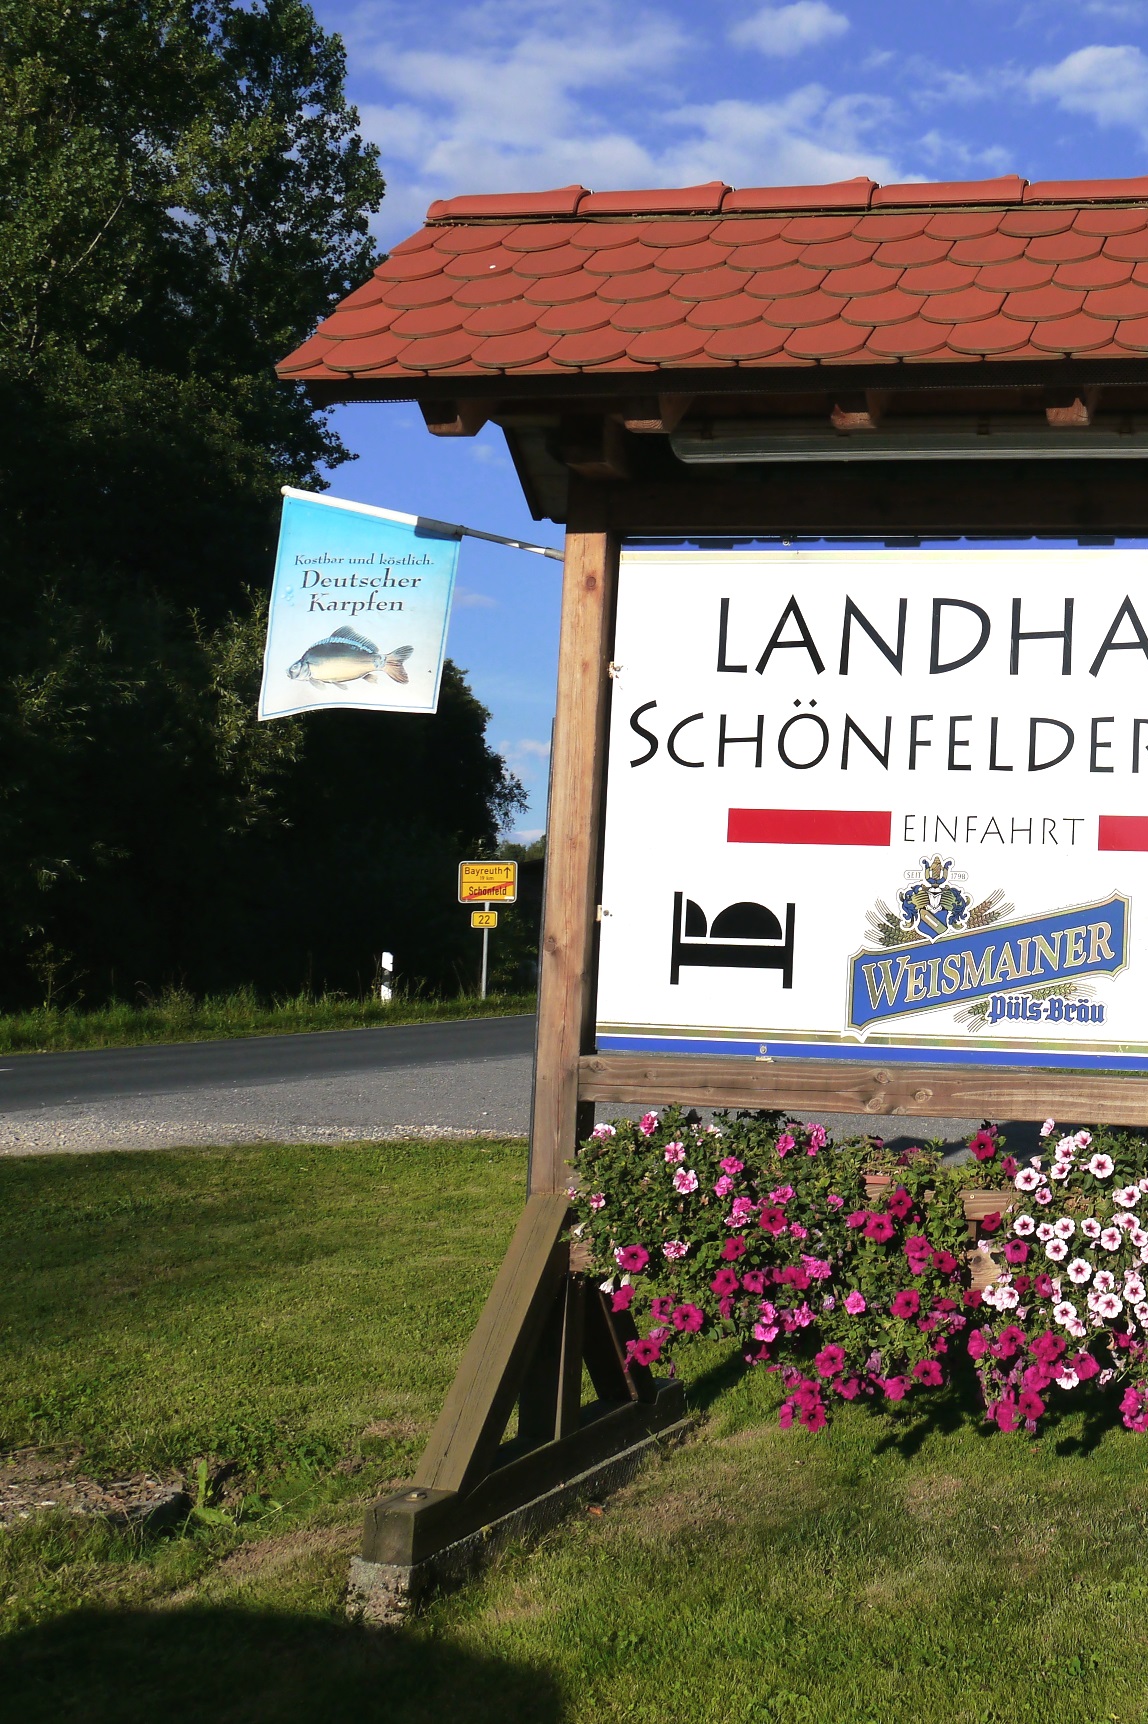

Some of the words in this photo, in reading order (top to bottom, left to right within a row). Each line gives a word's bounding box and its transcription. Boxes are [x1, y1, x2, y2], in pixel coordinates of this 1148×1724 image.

[294, 553, 345, 566] Kostbar
[348, 552, 375, 566] und
[301, 568, 421, 589] Deutscher
[307, 590, 404, 617] Karpfen
[904, 814, 1085, 846] EINFAHRT
[464, 867, 502, 876] Bayreuth
[906, 871, 922, 879] SEIT
[468, 886, 507, 895] Schönfeld
[478, 915, 490, 925] 22
[862, 922, 1115, 1010] WEISMAINER
[989, 996, 1106, 1024] Püls-Bräu
